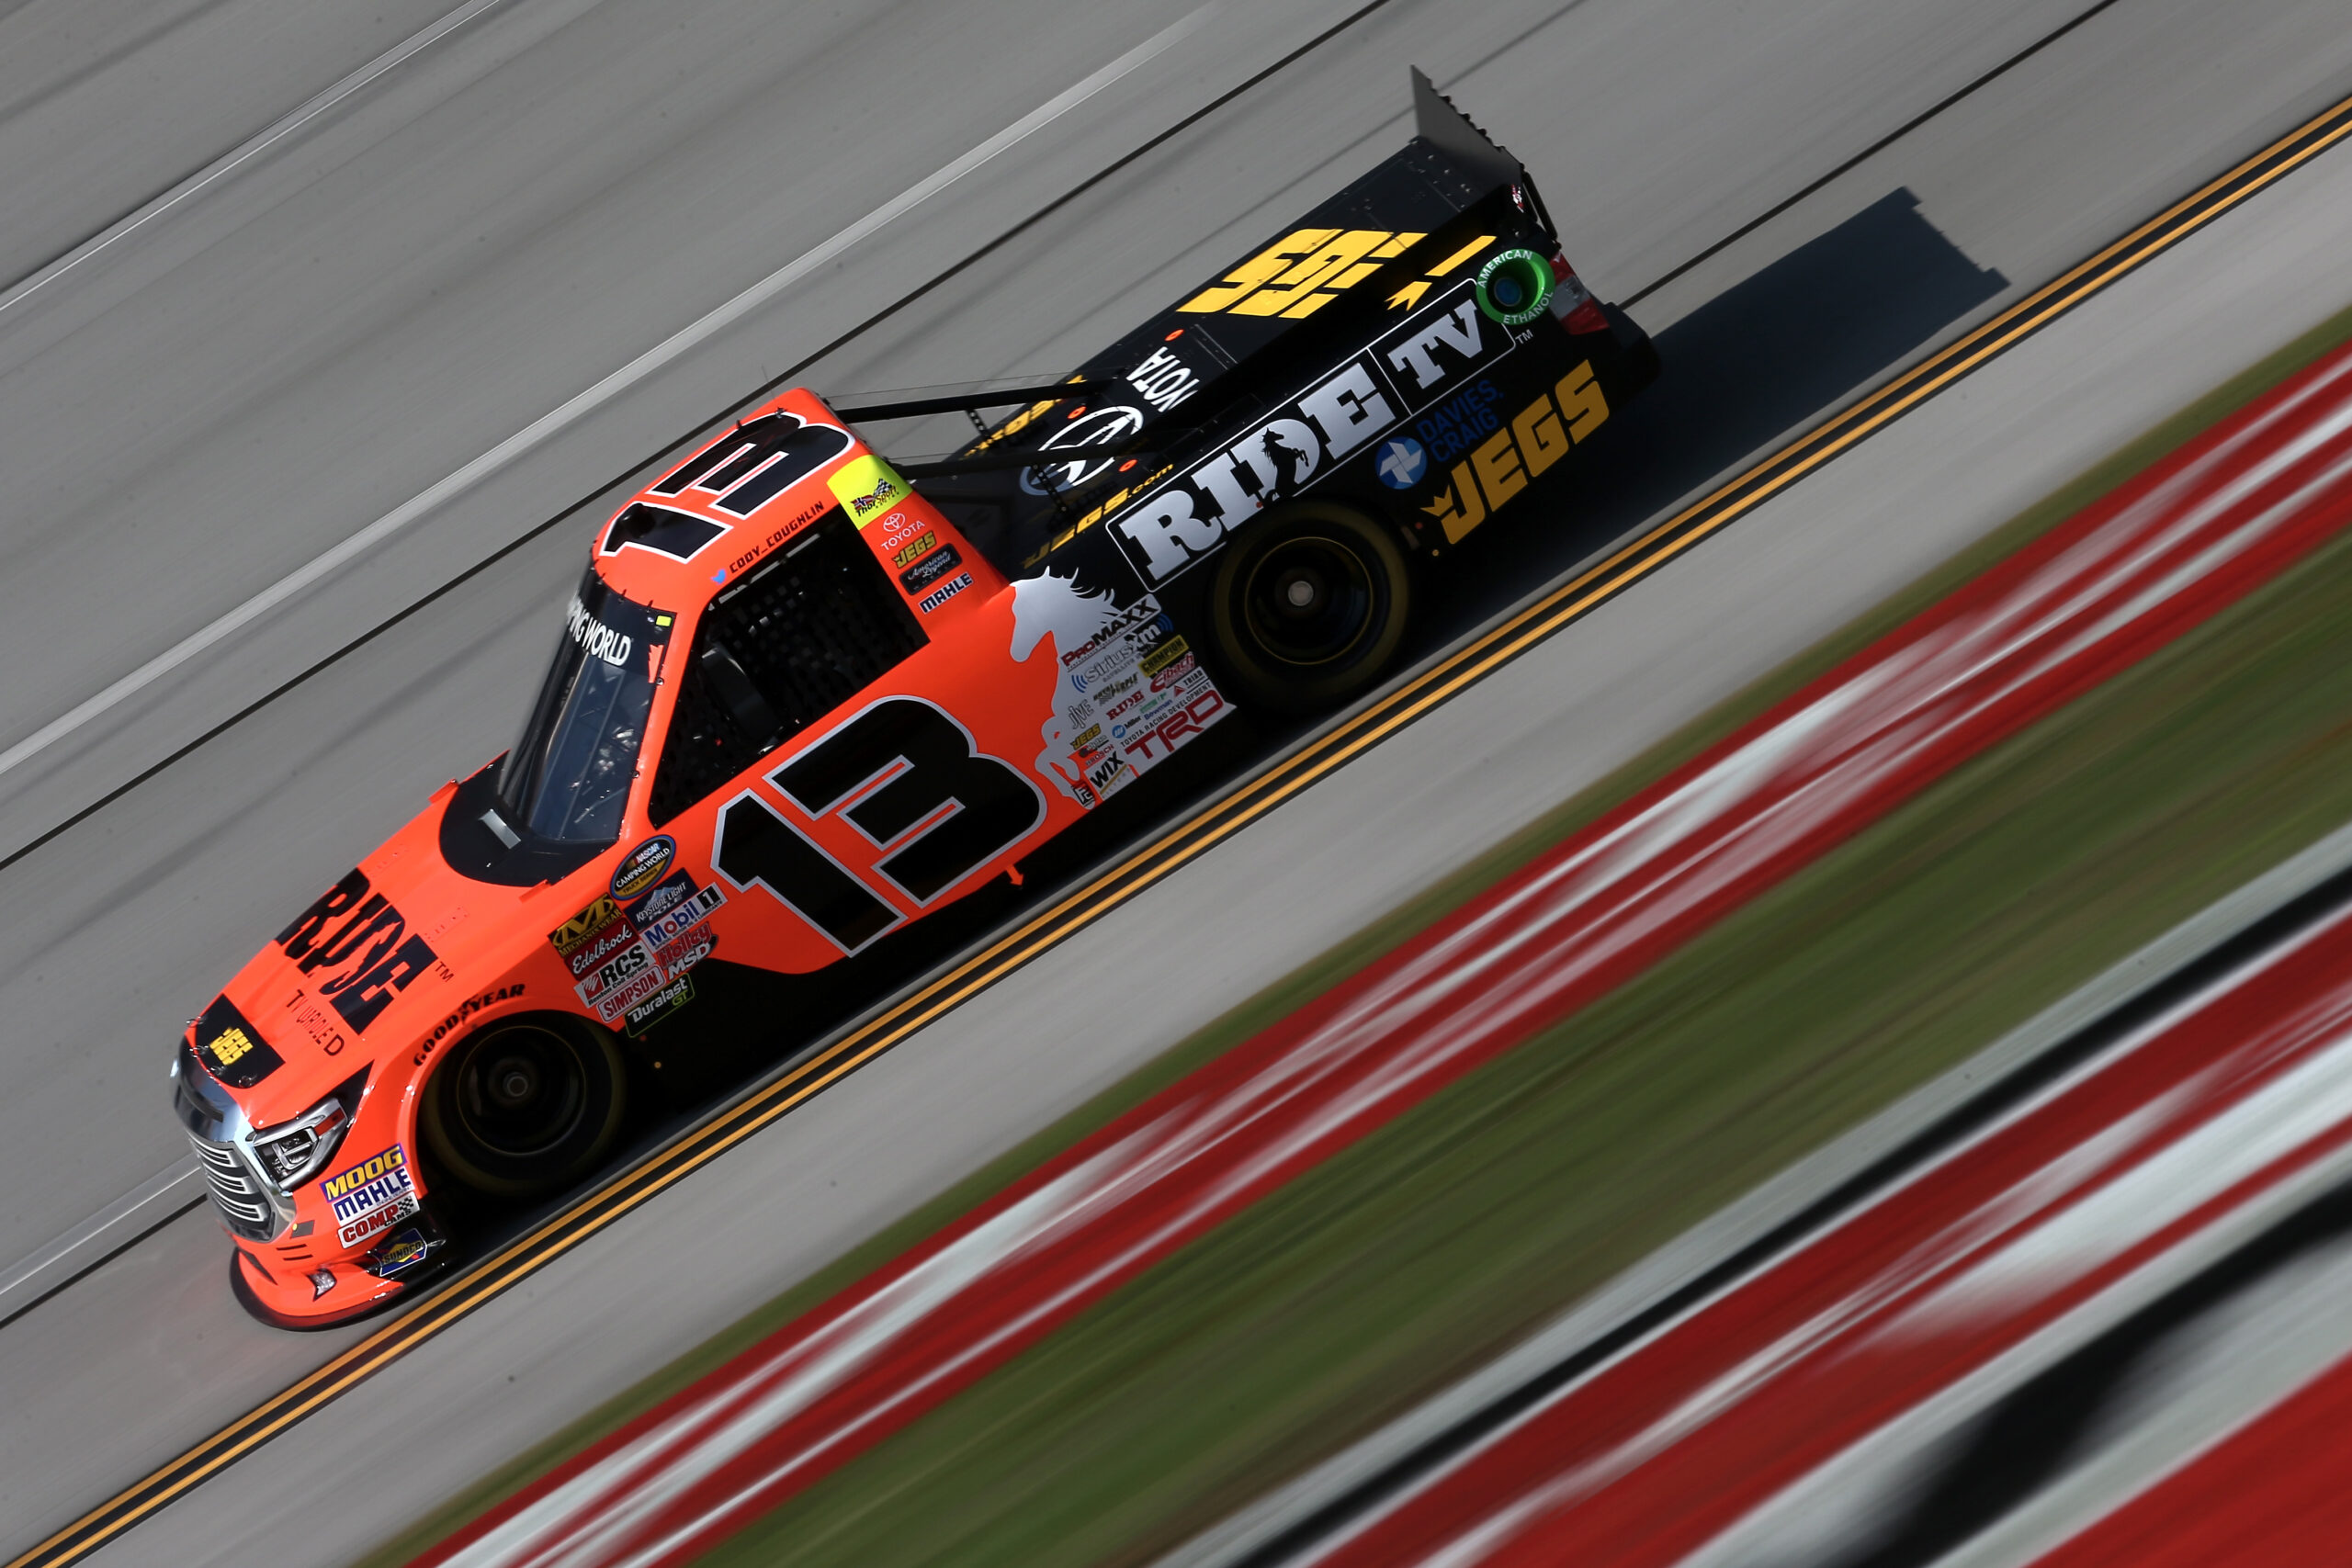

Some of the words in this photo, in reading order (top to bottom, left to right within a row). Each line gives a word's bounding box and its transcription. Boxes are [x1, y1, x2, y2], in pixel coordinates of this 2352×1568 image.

[1477, 250, 1532, 288] AMERICAN
[1503, 290, 1554, 324] ETHANOL
[1515, 329, 1534, 345] TM
[1118, 363, 1396, 580] RIDE
[1387, 299, 1484, 389] TV
[1419, 358, 1610, 545] JEGS
[1430, 407, 1499, 463] CRAIG
[599, 412, 856, 565] 13
[856, 485, 898, 518] ThorSport
[880, 518, 925, 551] TOYOTA
[891, 530, 939, 569] JEGS
[907, 548, 949, 580] American
[920, 573, 973, 614] MAHLE
[582, 617, 632, 667] WORLD
[1141, 637, 1184, 671] CHAMPION
[1148, 650, 1195, 693] Eibach
[1182, 669, 1203, 685] TRIAD
[1105, 690, 1144, 720] RIDE
[1121, 729, 1146, 748] TOYOTA
[1144, 712, 1169, 732] RACING
[1168, 682, 1213, 716] DEVELOPMENT
[1124, 689, 1225, 761] TRD
[1070, 722, 1102, 750] JEGS
[1090, 750, 1125, 789] WIX
[710, 694, 1048, 959] 13
[615, 863, 646, 888] CAMPING
[644, 846, 671, 868] WORLD
[635, 842, 661, 863] NASCAR
[622, 879, 639, 893] TRUCK
[634, 896, 668, 922] KEYSTONE
[665, 881, 687, 899] LIGHT
[601, 908, 623, 932] WEAR
[644, 900, 700, 947] Mobil
[648, 894, 683, 920] POLE
[274, 867, 439, 1036] RIDE
[572, 924, 633, 976] Edelbrock
[656, 921, 713, 964] Holley
[669, 942, 711, 981] MSD
[435, 961, 455, 983] TM
[599, 943, 646, 987] RCS
[587, 986, 612, 1005] Renton
[604, 969, 661, 1018] SIMPSON
[628, 976, 689, 1024] Duralast
[672, 988, 689, 1007] GT
[413, 984, 526, 1067] GOODYEAR
[324, 1145, 403, 1201] MOOG
[334, 1168, 412, 1222] MAHLE
[343, 1203, 399, 1243] COMP
[384, 1210, 413, 1227] CAMS
[382, 1240, 424, 1265] SUNOCO
